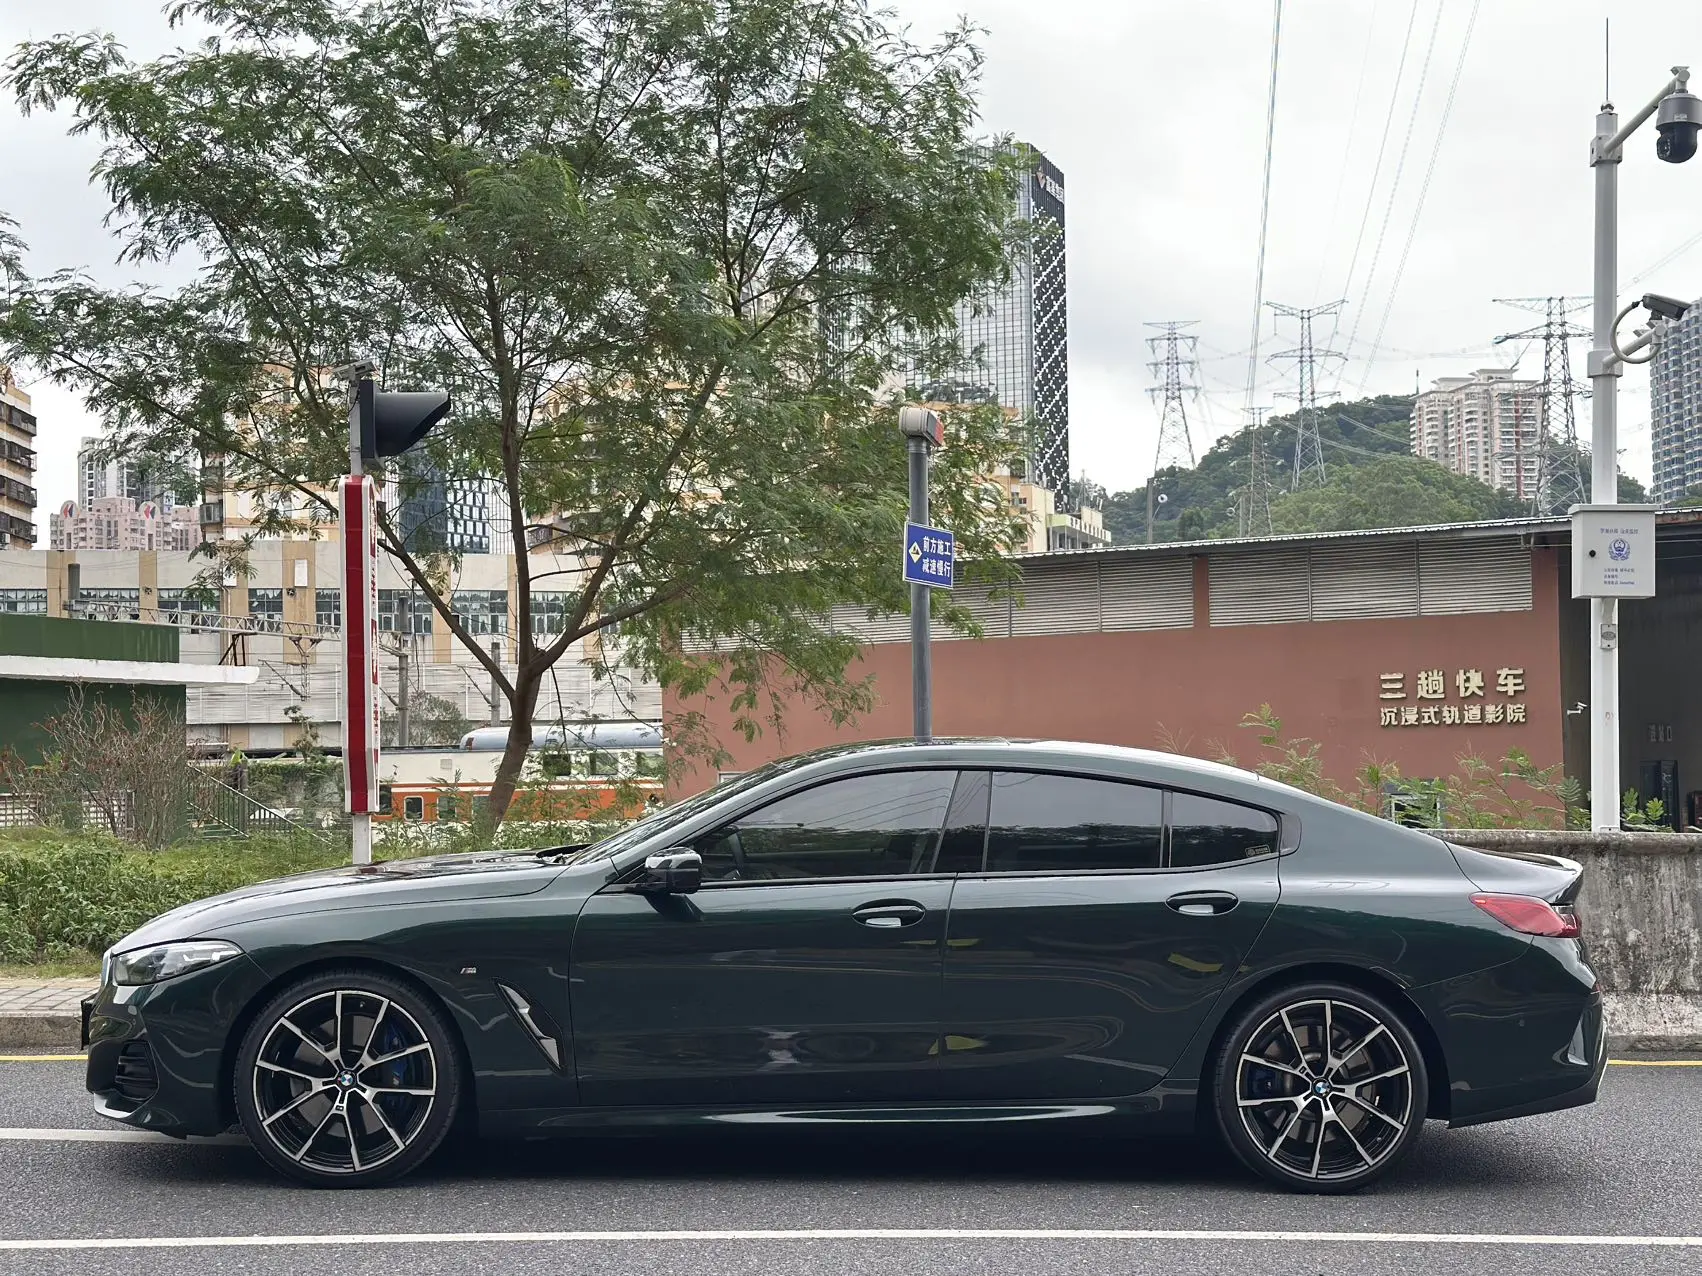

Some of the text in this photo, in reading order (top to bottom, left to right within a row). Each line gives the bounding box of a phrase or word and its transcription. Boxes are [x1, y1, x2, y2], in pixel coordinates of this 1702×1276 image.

[923, 536, 951, 556] 前方施工
[922, 557, 951, 578] 减速慢行
[1379, 667, 1526, 700] 三趟快车
[1380, 703, 1526, 727] 沉浸式轨道影院
